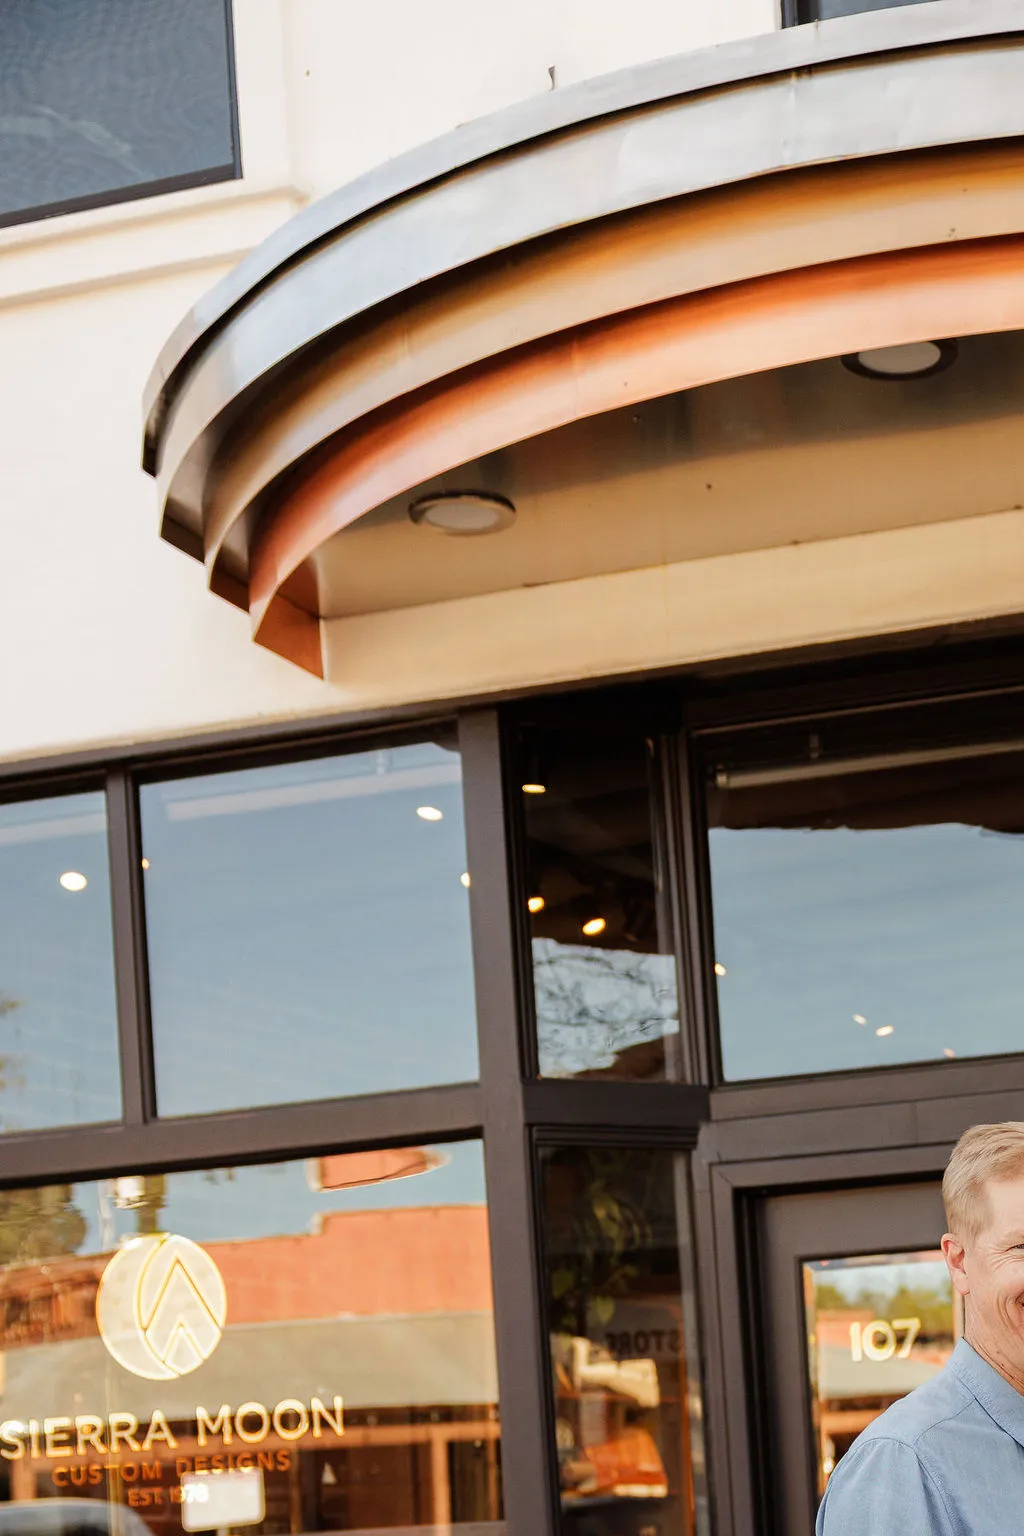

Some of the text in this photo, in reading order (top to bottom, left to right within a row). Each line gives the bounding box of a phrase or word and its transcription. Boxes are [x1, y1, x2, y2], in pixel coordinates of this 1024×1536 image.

[849, 1317, 922, 1362] 107
[0, 1395, 345, 1460] SIERRA MOON
[52, 1450, 291, 1487] CUSTOM DESIGNS
